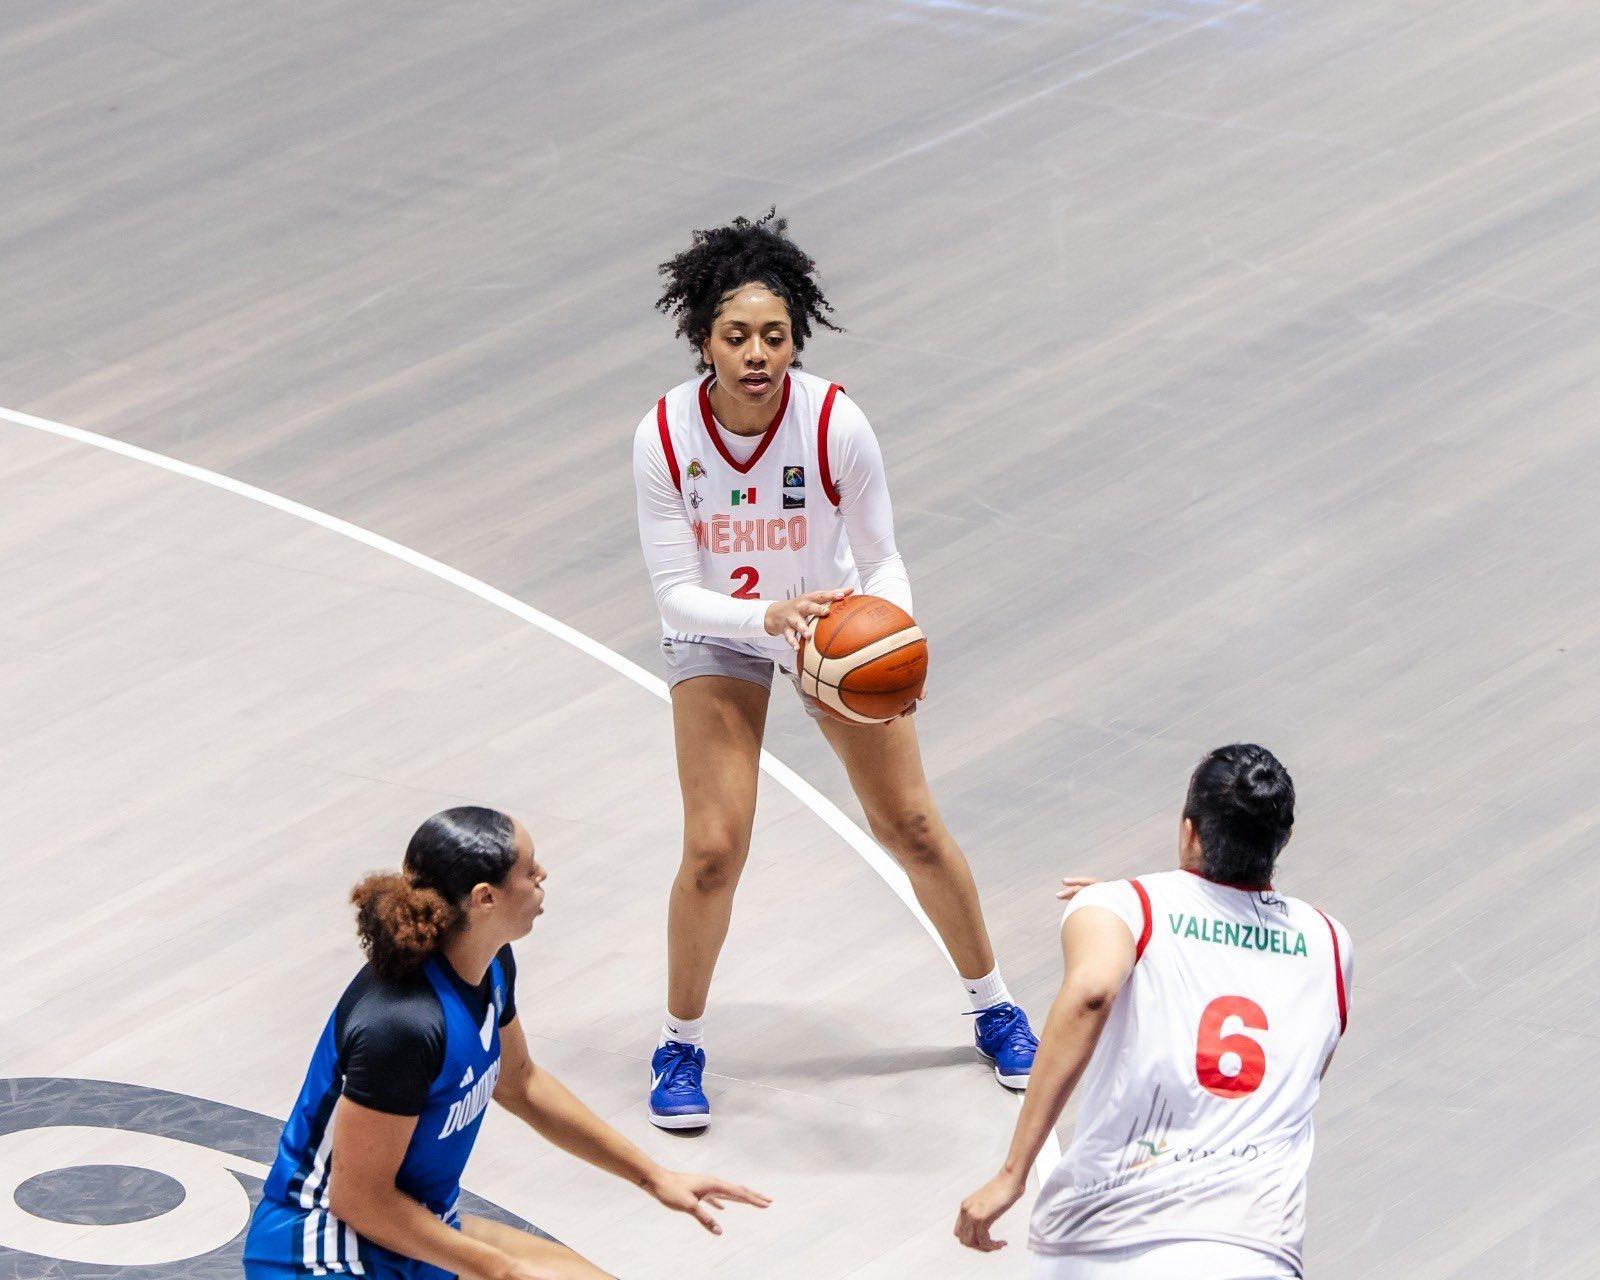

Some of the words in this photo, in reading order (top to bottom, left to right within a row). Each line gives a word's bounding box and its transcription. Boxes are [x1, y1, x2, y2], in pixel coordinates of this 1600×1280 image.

[730, 566, 760, 600] 2
[1168, 913, 1308, 957] VALENZUELA
[1195, 995, 1269, 1099] 6
